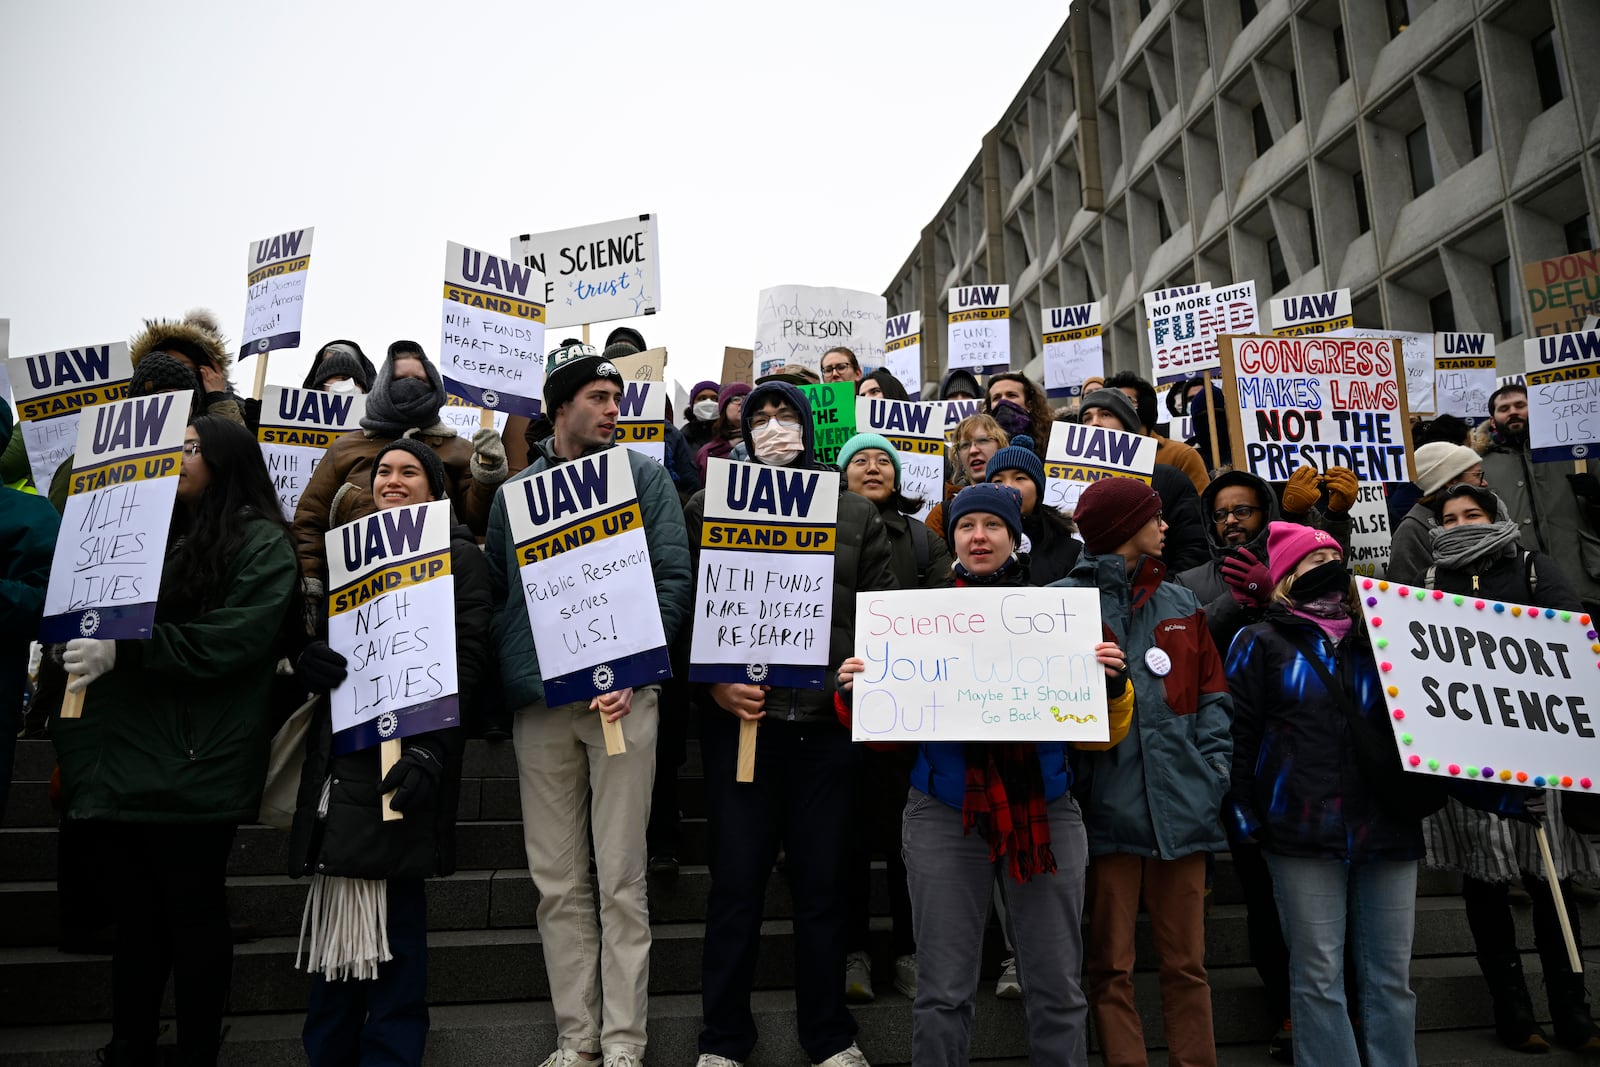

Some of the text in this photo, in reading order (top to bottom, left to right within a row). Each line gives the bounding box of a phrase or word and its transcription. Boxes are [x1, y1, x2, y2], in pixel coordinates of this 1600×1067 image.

[256, 230, 304, 264] UAW
[560, 232, 645, 275] SCIENCE
[250, 260, 306, 286] STAND UP
[462, 247, 532, 297] UAW
[248, 281, 268, 301] NIH
[545, 272, 630, 303] E trust
[958, 286, 999, 307] UAW
[1153, 305, 1171, 317] NO
[1176, 296, 1211, 312] MORE
[1216, 287, 1251, 303] CUTS!
[1528, 275, 1600, 313] DEFU
[448, 289, 541, 319] STAND UP
[764, 293, 800, 318] And
[810, 307, 833, 323] you
[951, 310, 1006, 322] STAND UP
[1051, 305, 1092, 328] UAW
[1283, 292, 1337, 321] UAW
[446, 314, 532, 342] NIH FUNDS
[783, 320, 852, 339] PRISON
[885, 314, 911, 338] AW
[1046, 328, 1098, 343] STAND UP
[1154, 302, 1255, 348] FUND
[1330, 319, 1349, 331] UP
[444, 331, 544, 365] HEART DISEASE
[904, 337, 917, 347] UP
[960, 352, 1005, 361] FREEZE
[964, 339, 991, 350] DON'T
[1157, 340, 1220, 369] SCIEN
[1444, 334, 1485, 354] UAW
[1539, 331, 1600, 364] UAW
[26, 345, 109, 389] UAW
[452, 354, 523, 381] RESEARCH
[1240, 340, 1392, 376] CONGRESS
[1408, 368, 1424, 377] YOU
[1479, 360, 1493, 368] UP
[1439, 373, 1467, 390] NIH
[1531, 367, 1590, 386] STAND
[24, 392, 98, 418] STAND
[800, 386, 835, 408] AD
[1238, 377, 1398, 410] MAKES LAWS
[1539, 378, 1600, 405] SCIEN
[279, 388, 354, 426] UAW
[813, 408, 838, 424] HE
[869, 399, 931, 434] UAW
[1552, 401, 1599, 420] SERVE
[31, 421, 69, 444] THE
[92, 394, 174, 455] UAW
[263, 430, 329, 445] STAND
[632, 427, 659, 440] UP
[1256, 410, 1392, 443] NOT THE
[1556, 419, 1596, 443] U.S.
[918, 442, 939, 453] UP
[1065, 425, 1142, 467] UAW
[73, 458, 174, 494] STAND UP
[268, 453, 298, 472] NIH
[1247, 443, 1404, 481] PRESIDENT
[524, 454, 608, 525] UAW
[727, 463, 820, 518] UAW
[903, 481, 928, 494] ICAL
[1356, 485, 1384, 503] JECT
[80, 484, 139, 532] NIH
[343, 505, 428, 572] UAW
[525, 511, 634, 566] STAND UP
[709, 527, 828, 548] STAND UP
[1351, 514, 1387, 534] ALSE
[76, 533, 146, 567] SAVES
[1350, 545, 1392, 562] ROMISE
[335, 559, 443, 613] STAND UP
[526, 549, 648, 603] Public Research
[706, 563, 824, 594] NIH FUNDS
[65, 575, 143, 612] LIVES
[560, 591, 608, 620] serves
[355, 591, 410, 636] NIH
[707, 599, 825, 619] RARE DISEASE
[869, 594, 1076, 636] Science Got
[352, 626, 430, 672] SAVES
[563, 614, 618, 655] U.S.!
[718, 624, 816, 650] RESEARCH
[864, 641, 959, 683] Your
[972, 640, 1101, 685] Worm
[1408, 621, 1571, 679] SUPPORT
[353, 662, 443, 715] LIVES
[957, 686, 1091, 707] Maybe It Should
[858, 689, 945, 734] Out
[981, 707, 1042, 724] Go Back
[1422, 676, 1595, 738] SCIENCE
